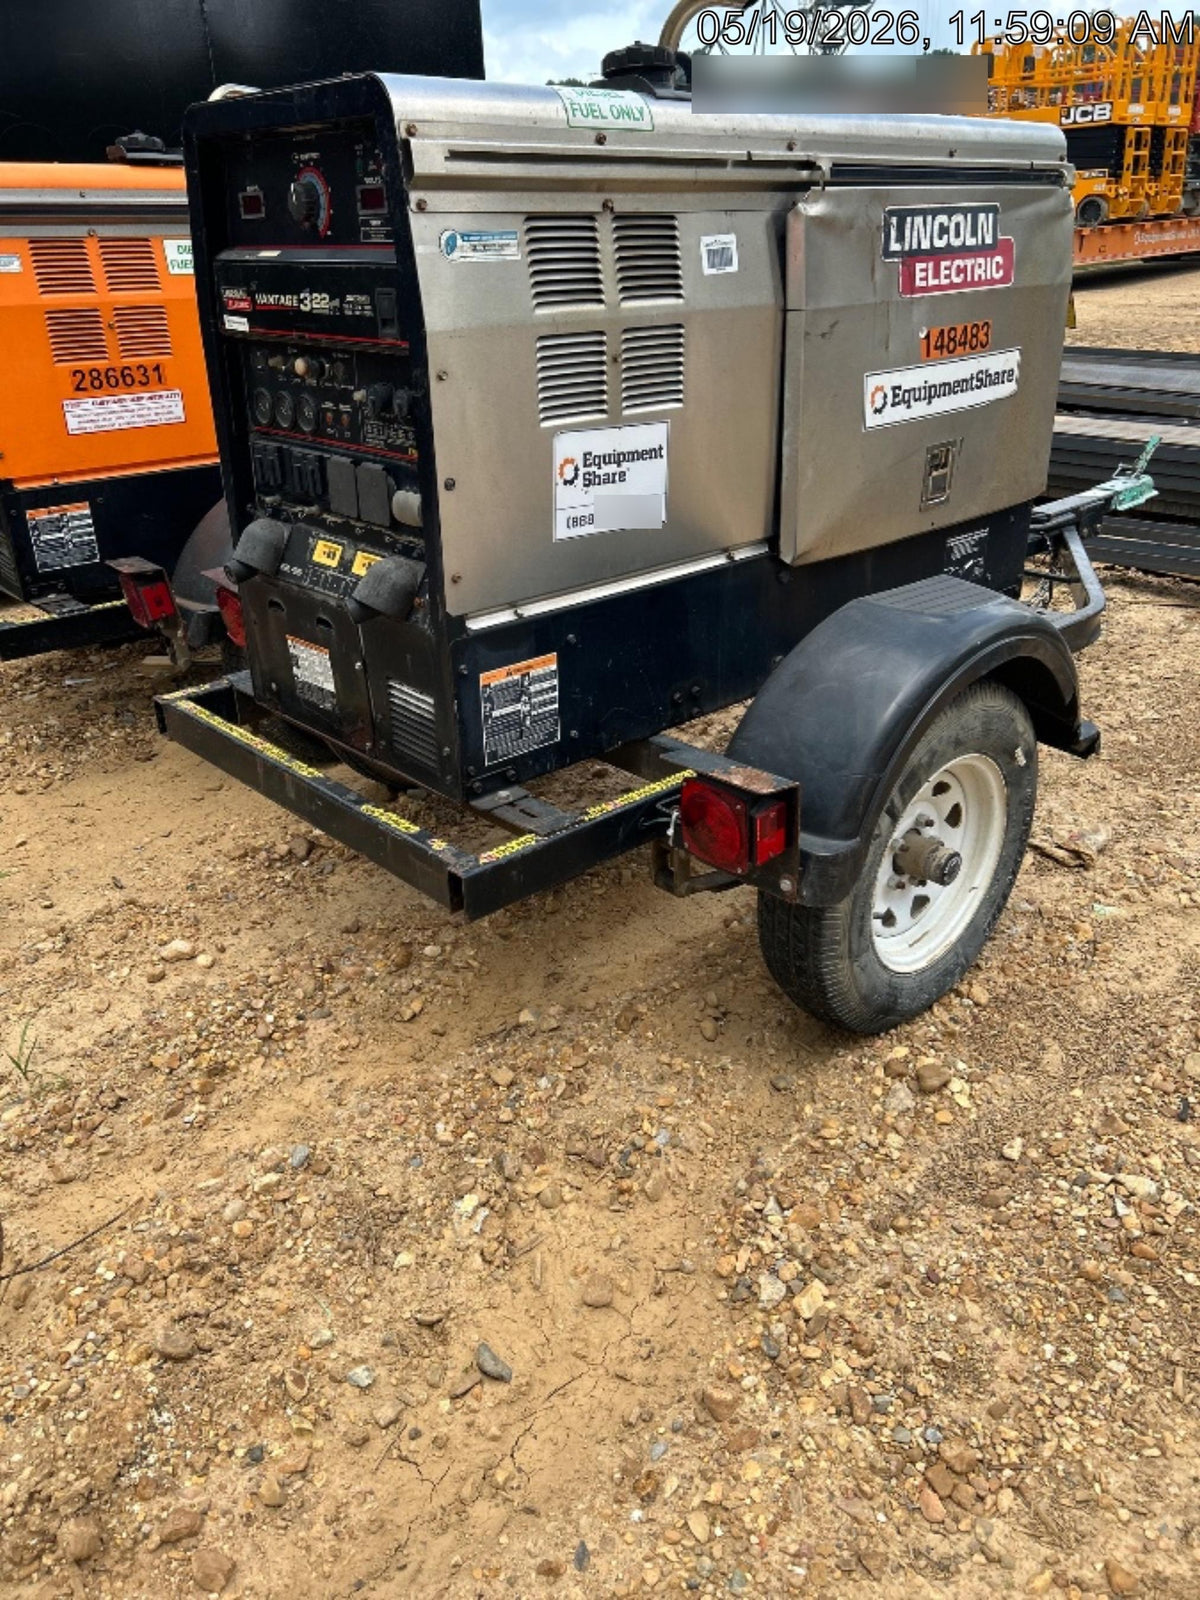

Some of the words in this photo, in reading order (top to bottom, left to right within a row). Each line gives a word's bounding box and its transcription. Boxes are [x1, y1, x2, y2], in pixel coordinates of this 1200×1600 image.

[569, 102, 609, 120] FUEL
[609, 104, 645, 122] ONLY
[1061, 103, 1112, 124] JCB
[888, 212, 994, 252] LINCOLN
[914, 256, 1004, 287] ELECTRIC
[255, 292, 299, 307] VANTAGE
[299, 292, 330, 312] 322
[923, 321, 991, 358] 148483
[72, 364, 163, 392] 286631
[889, 367, 1015, 409] EquipmentShare
[582, 443, 664, 470] Equipment
[582, 470, 627, 488] Share
